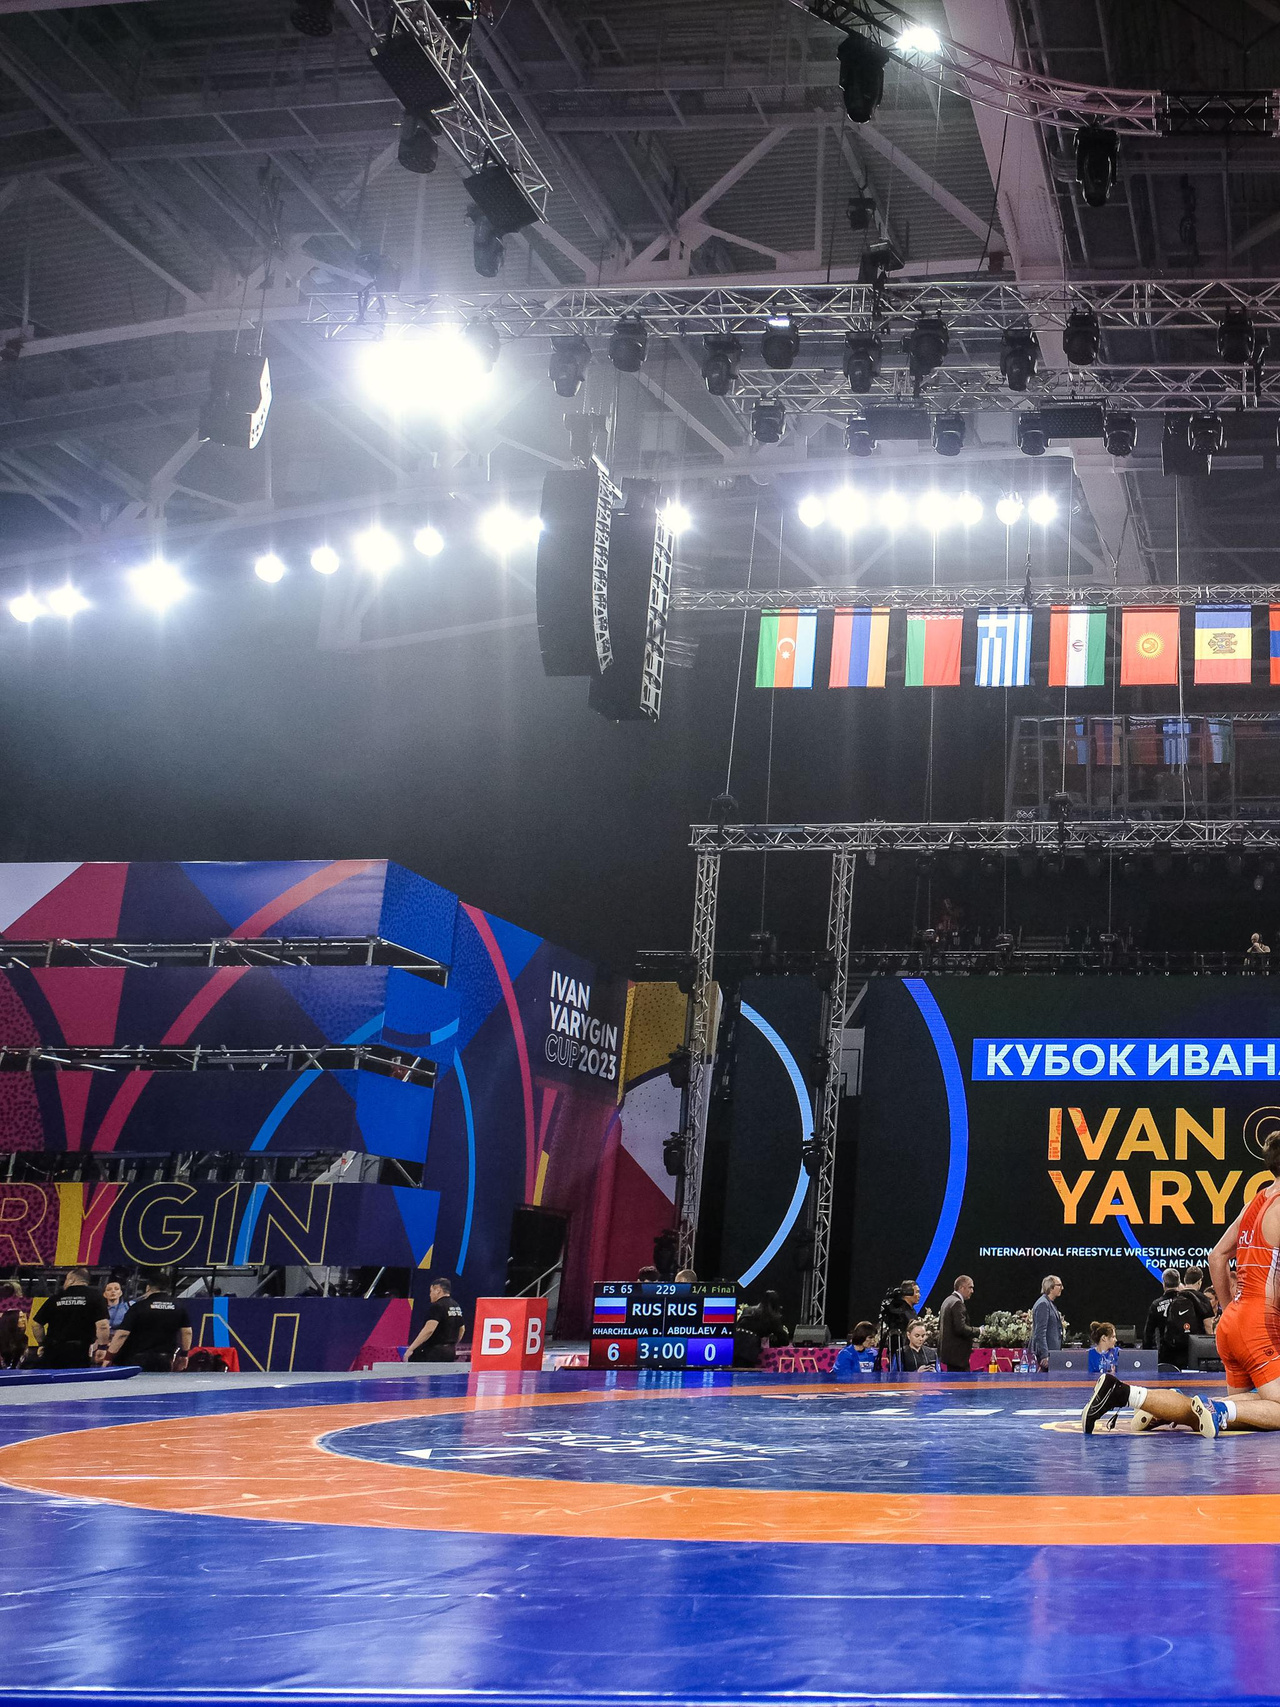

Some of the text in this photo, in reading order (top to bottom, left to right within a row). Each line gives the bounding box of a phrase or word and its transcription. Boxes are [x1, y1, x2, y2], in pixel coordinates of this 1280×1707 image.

[550, 970, 591, 1012] IVAN
[549, 1000, 618, 1052] YARYGIN
[986, 1043, 1137, 1076] КУБОК
[1047, 1107, 1226, 1161] IVAN
[979, 1247, 1213, 1257] INTERNATIONAL FREESTYLE WRESTLING COM
[1145, 1259, 1210, 1269] FOR MEN AN
[603, 1284, 633, 1294] FS 65
[655, 1284, 677, 1295] 229
[692, 1285, 736, 1294] 1/4 Final
[632, 1303, 662, 1317] RUS
[667, 1303, 698, 1317] RUS
[480, 1317, 513, 1356] B
[525, 1317, 543, 1356] B
[592, 1328, 663, 1336] KHARCHILAVA D.
[667, 1326, 733, 1335] ABDULAEV A.
[607, 1342, 620, 1362] 6
[639, 1342, 685, 1360] 3:00
[704, 1342, 717, 1362] 0
